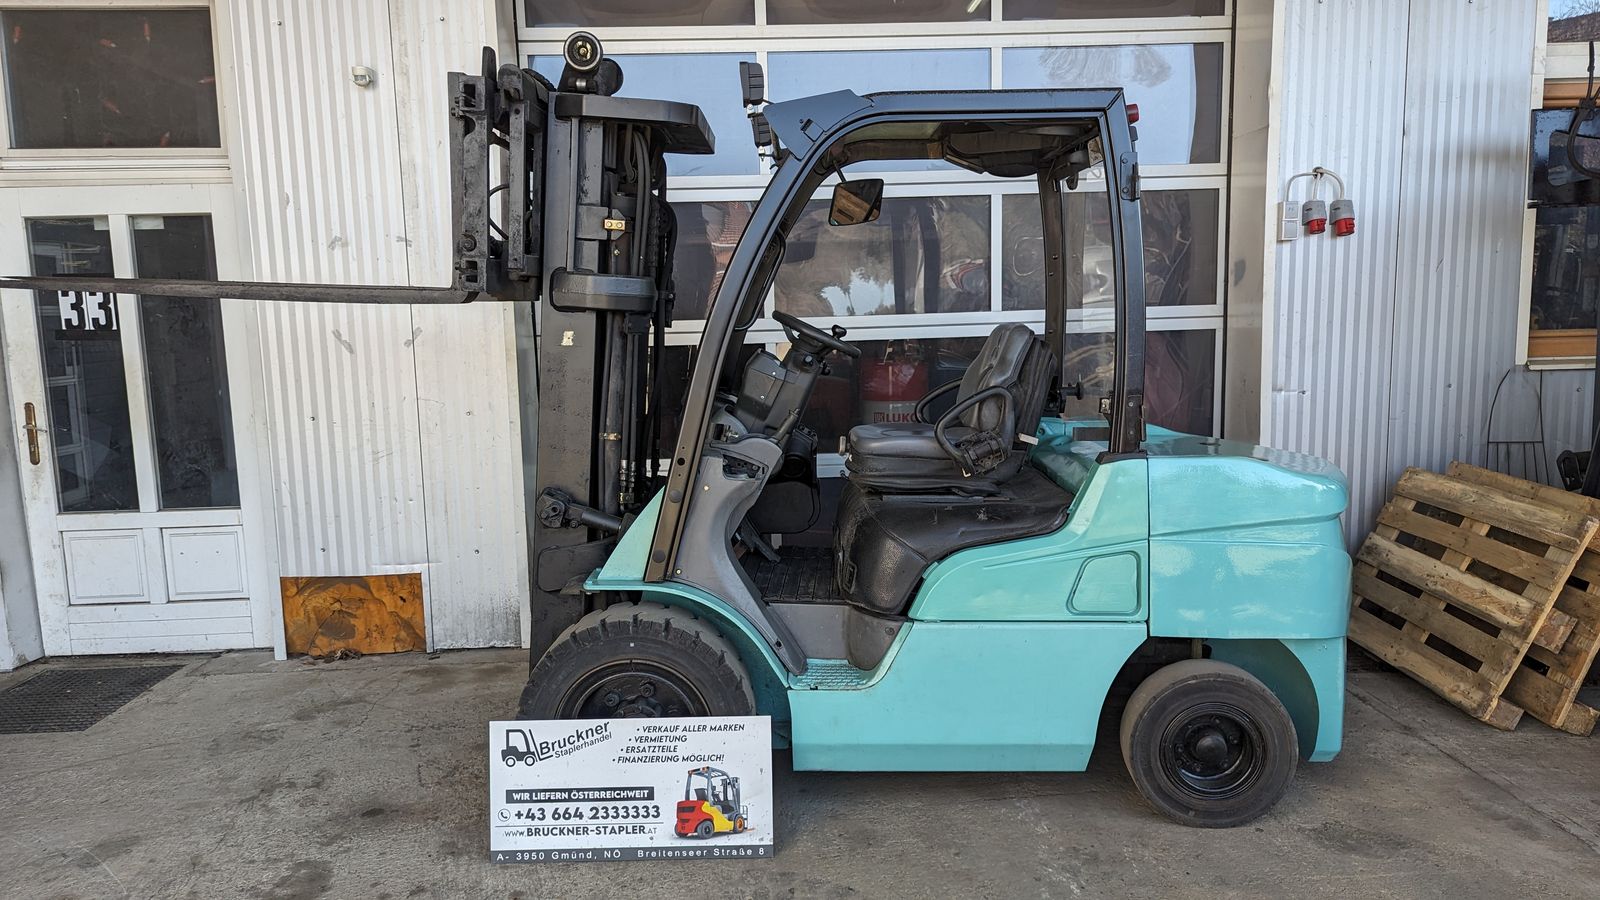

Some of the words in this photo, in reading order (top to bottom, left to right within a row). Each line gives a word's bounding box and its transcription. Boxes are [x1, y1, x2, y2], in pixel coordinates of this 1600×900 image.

[60, 290, 114, 330] 33
[642, 725, 680, 733] VERKAUF
[682, 724, 708, 733] ALLER
[709, 723, 745, 732] MARKEN
[540, 721, 610, 756] Bruckner
[634, 735, 688, 743] VERMIETUNG
[554, 732, 612, 759] Staplerhandel
[625, 745, 678, 754] ERSATZTEILE
[617, 755, 680, 764] FINANZIERUNG
[681, 753, 725, 763] MÖGLICH!
[512, 792, 530, 801] WIR
[532, 791, 569, 800] LIEFERN
[570, 789, 649, 800] ÖSTERREICHWEIT
[514, 807, 546, 821] +43
[551, 807, 584, 821] 664
[588, 805, 660, 820] 2333333
[516, 852, 545, 861] 3950
[551, 851, 597, 860] Gmünd,
[603, 849, 621, 858] NÖ
[637, 849, 708, 858] Breitenseer
[713, 847, 753, 857] Straße
[758, 847, 765, 855] 8
